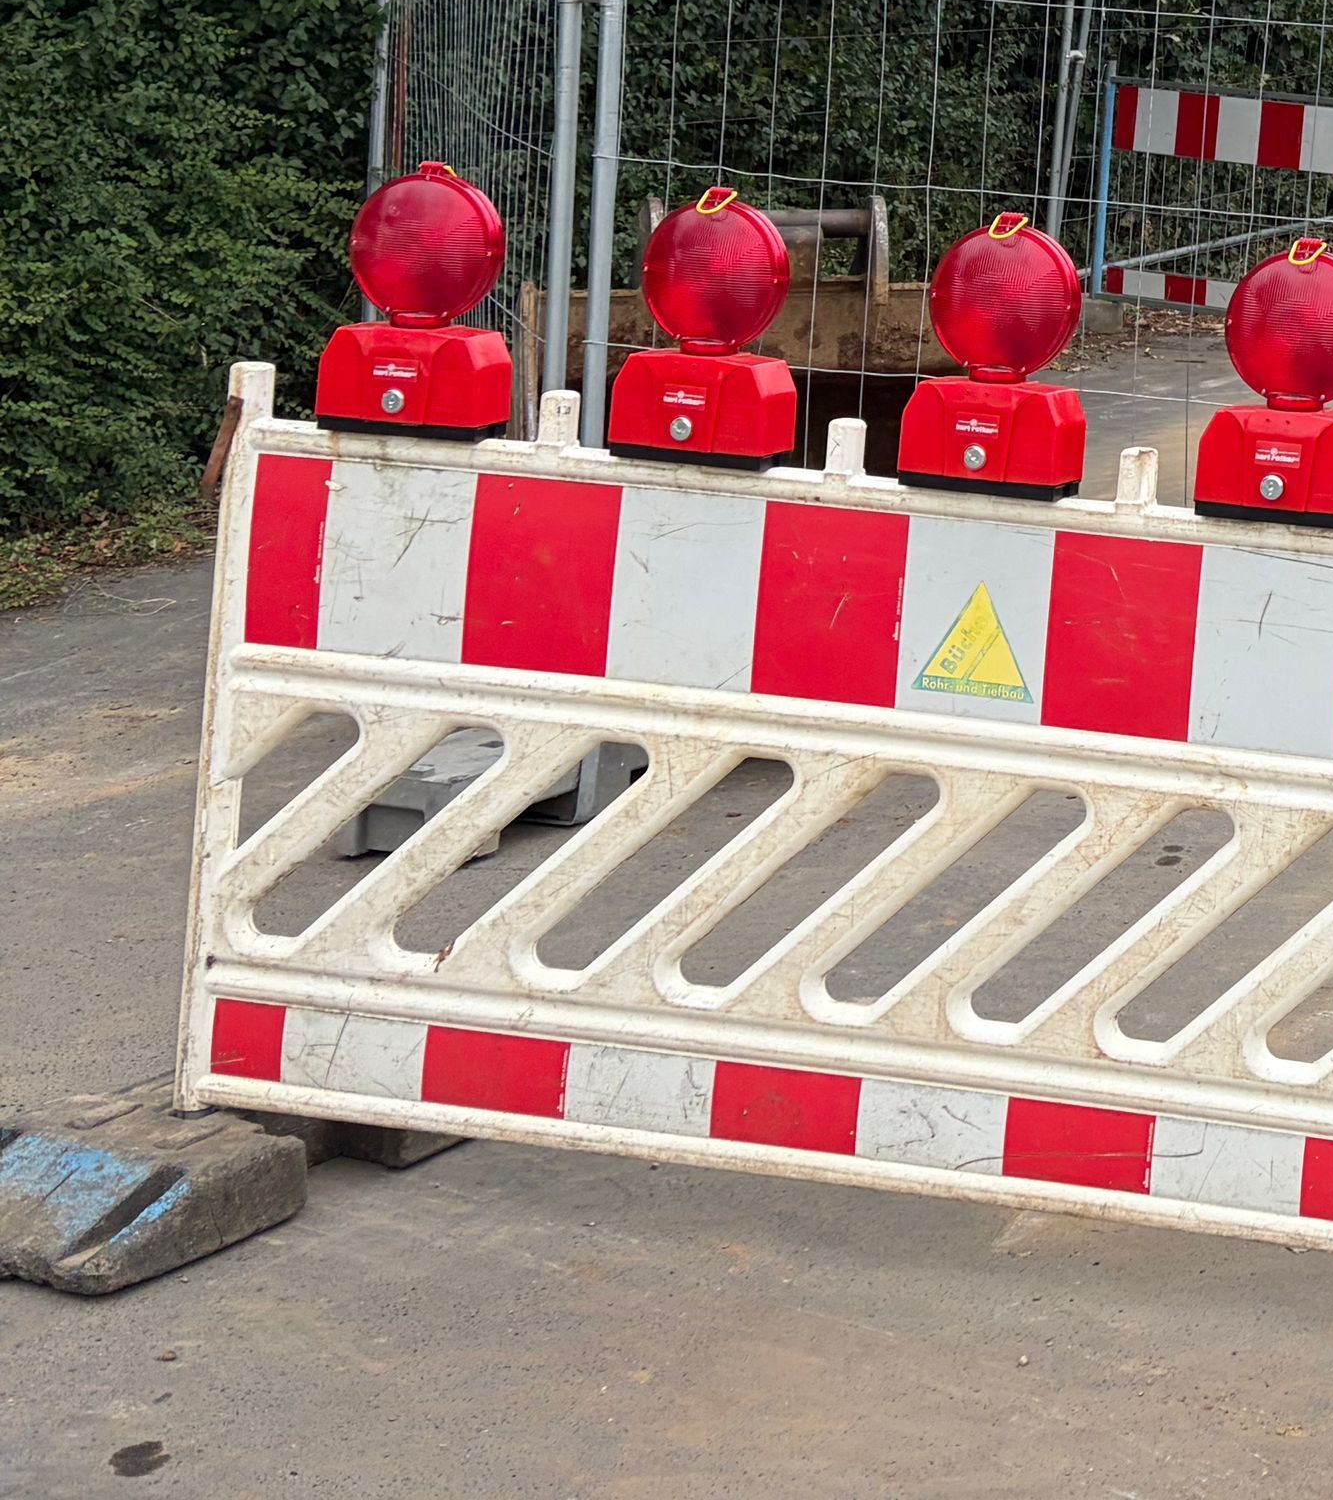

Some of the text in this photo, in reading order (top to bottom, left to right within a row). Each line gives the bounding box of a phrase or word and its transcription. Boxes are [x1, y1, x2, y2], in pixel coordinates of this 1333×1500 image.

[921, 677, 1025, 700] Rohr- und Tiefbau
